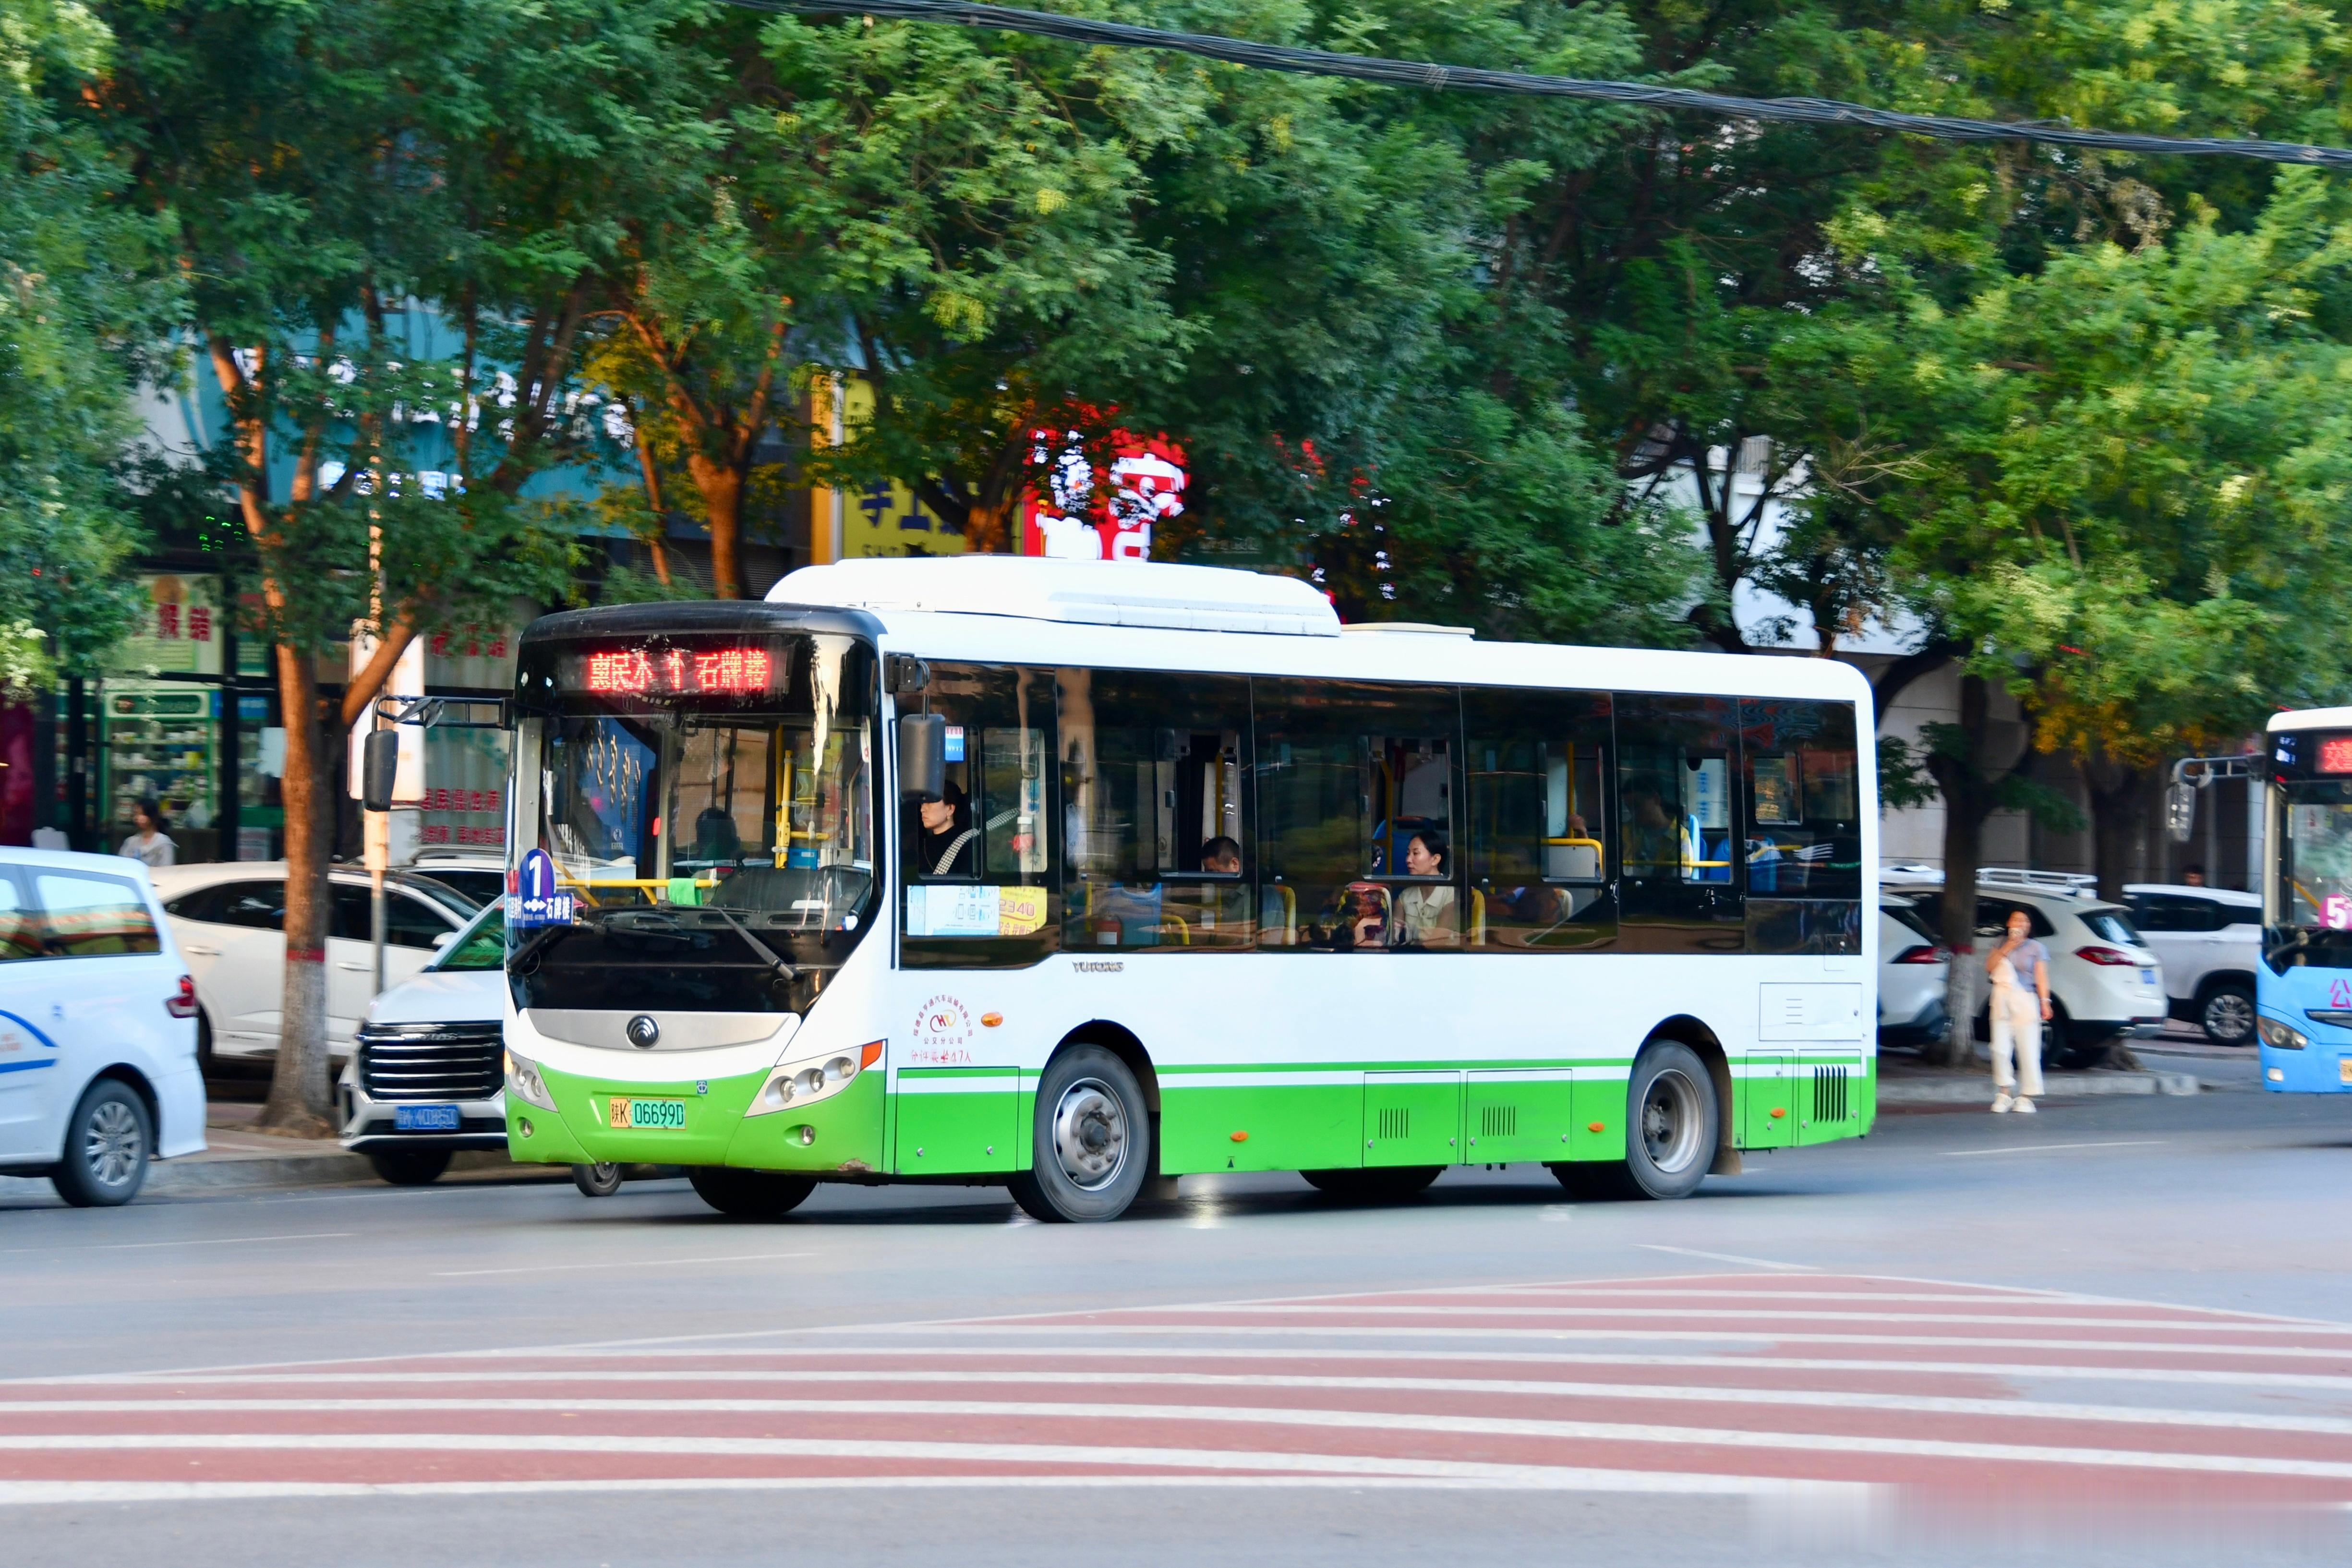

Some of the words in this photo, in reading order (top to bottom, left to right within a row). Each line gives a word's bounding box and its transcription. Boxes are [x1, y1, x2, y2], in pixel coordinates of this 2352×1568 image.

[668, 651, 680, 689] 1
[529, 855, 542, 897] 1
[546, 896, 570, 920] 石牌楼
[1072, 961, 1125, 973] YUTONG
[2329, 978, 2351, 1008] 公
